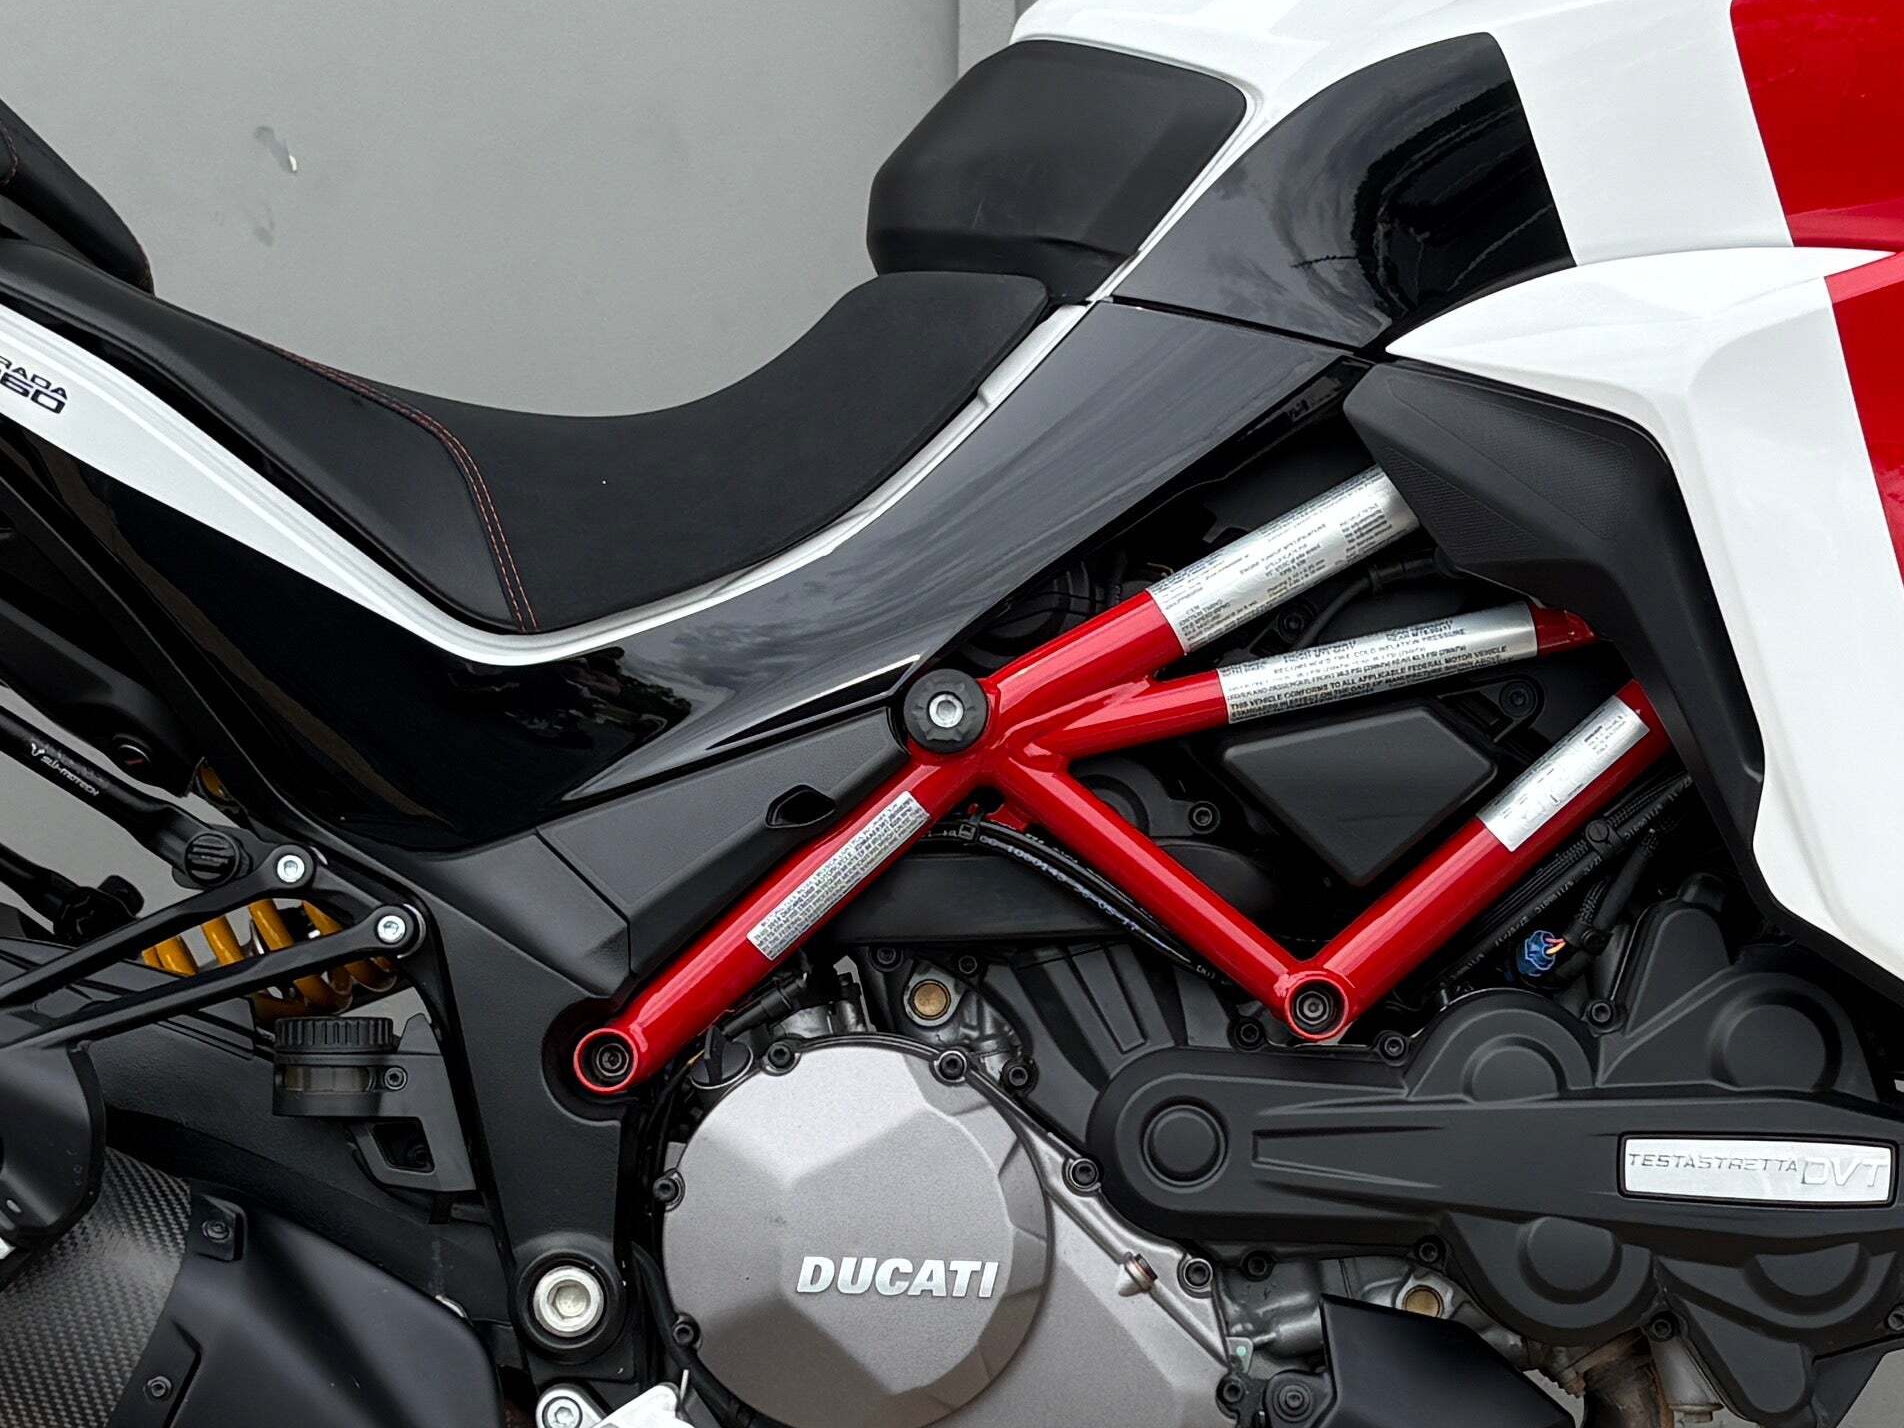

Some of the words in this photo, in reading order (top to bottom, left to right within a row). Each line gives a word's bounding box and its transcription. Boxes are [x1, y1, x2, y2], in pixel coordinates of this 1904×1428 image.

[1341, 677, 1356, 687] ALL
[1629, 1152, 1797, 1172] TESTASTRETTA
[1801, 1156, 1889, 1188] DVT
[796, 1256, 999, 1298] DUCATI
